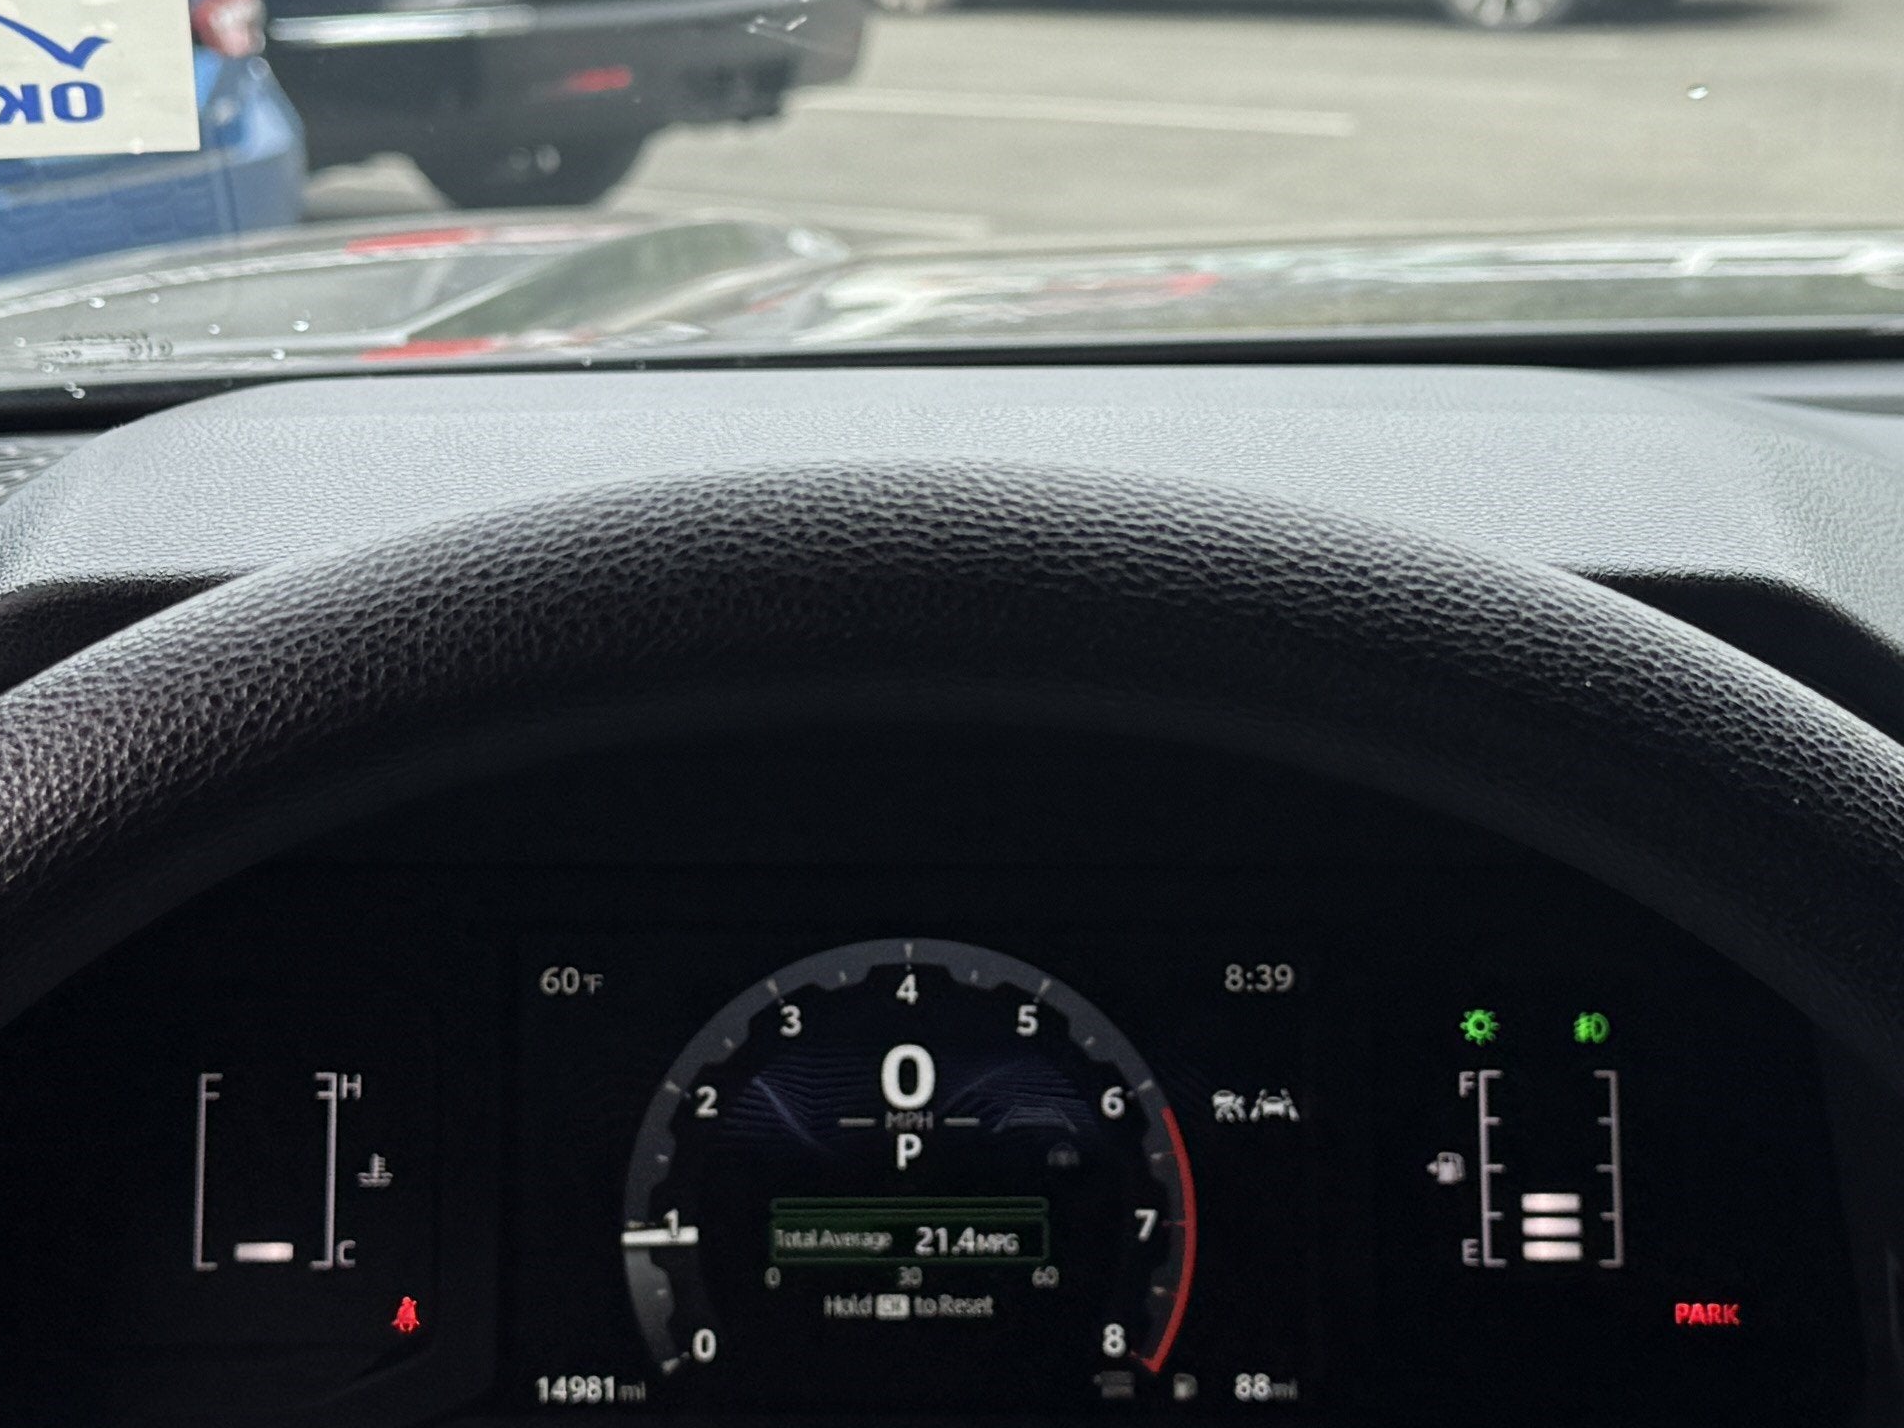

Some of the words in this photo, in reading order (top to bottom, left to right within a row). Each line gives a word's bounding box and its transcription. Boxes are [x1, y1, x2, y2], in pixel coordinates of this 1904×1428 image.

[896, 974, 919, 1006] 4
[1224, 963, 1295, 993] 8:39
[779, 1004, 803, 1038] 3
[1015, 1004, 1038, 1037] 5
[340, 1073, 363, 1100] H
[880, 1042, 936, 1111] 0
[1458, 1070, 1475, 1098] F
[695, 1085, 719, 1118] 2
[1100, 1085, 1126, 1119] 6
[884, 1110, 935, 1131] MPH
[897, 1132, 923, 1171] P
[773, 1228, 818, 1250] Total
[819, 1228, 894, 1253] Average
[1134, 1209, 1158, 1242] 7
[336, 1239, 356, 1269] C
[1460, 1238, 1479, 1268] E
[764, 1266, 782, 1289] 0
[897, 1266, 923, 1289] 30
[1032, 1266, 1060, 1289] 60
[822, 1293, 873, 1318] Hold
[913, 1294, 938, 1318] to
[938, 1293, 994, 1318] Reset
[1674, 1302, 1742, 1326] PARK
[692, 1328, 717, 1364] 0
[1102, 1322, 1127, 1358] 8
